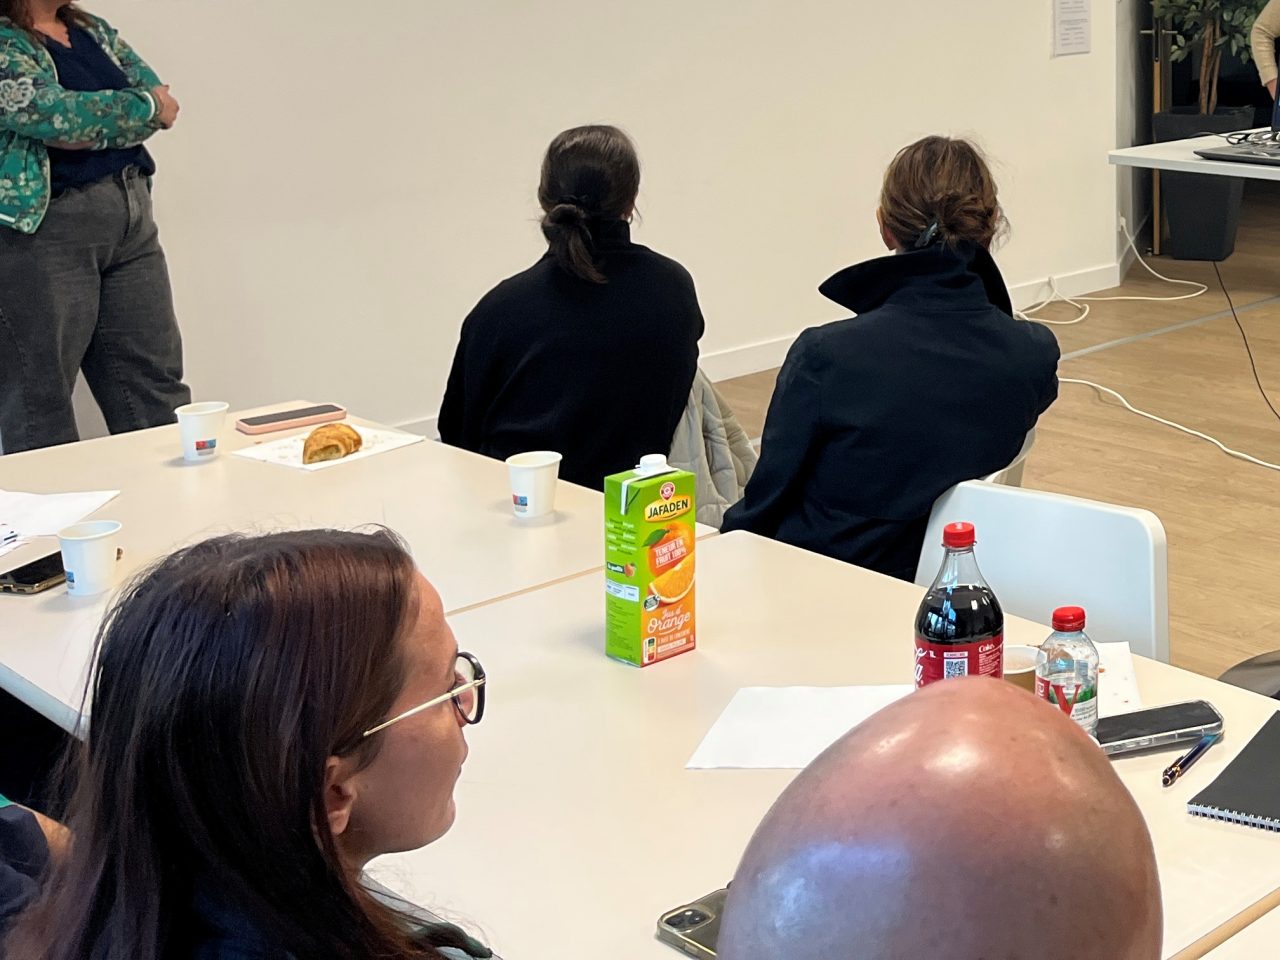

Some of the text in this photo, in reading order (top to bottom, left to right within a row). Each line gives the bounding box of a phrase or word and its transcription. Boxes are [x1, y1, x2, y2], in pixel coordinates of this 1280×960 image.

[647, 499, 689, 519] JAFADEN
[655, 541, 677, 557] TENEUR
[656, 551, 671, 566] FRUIT
[647, 611, 691, 634] Orange
